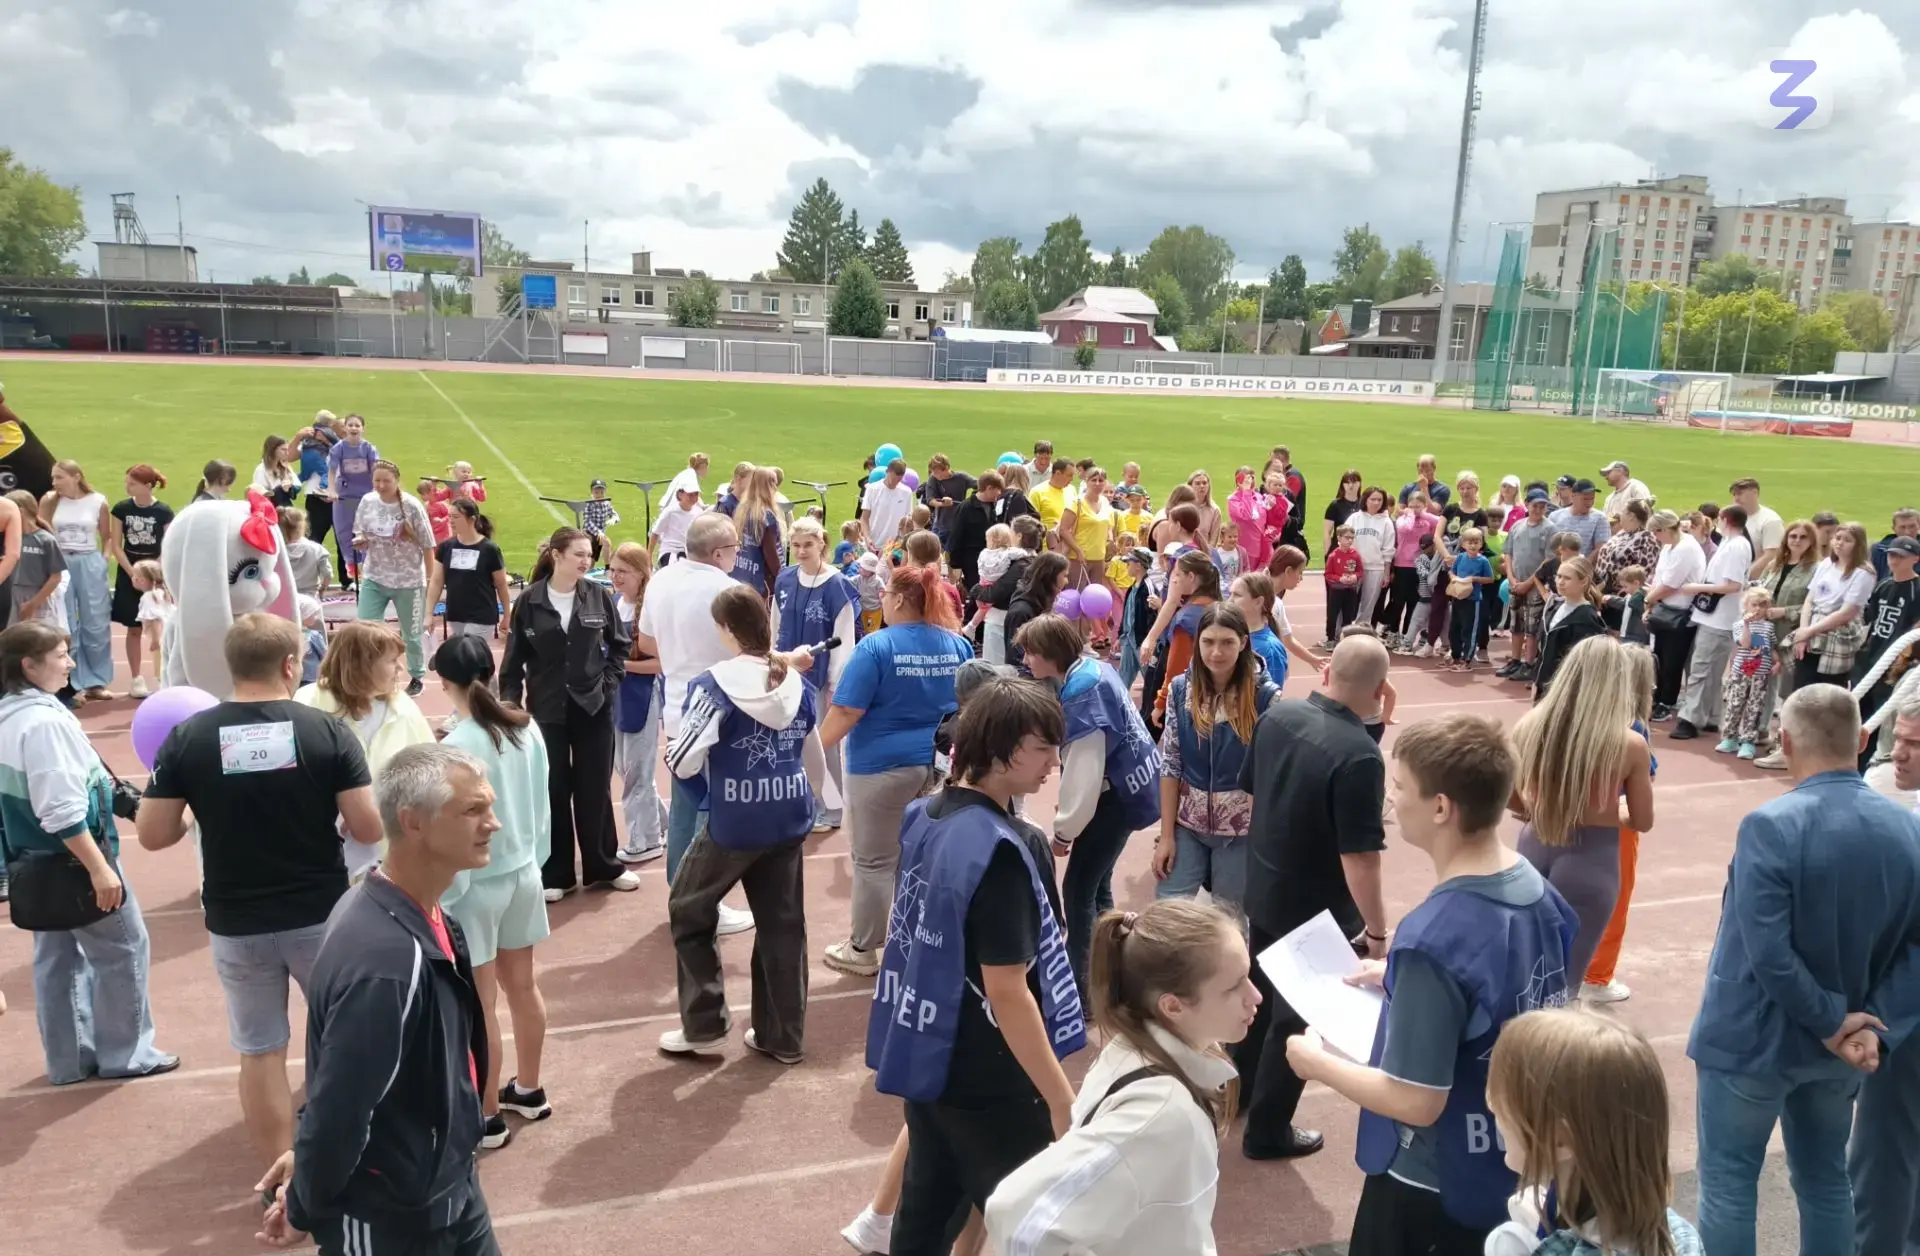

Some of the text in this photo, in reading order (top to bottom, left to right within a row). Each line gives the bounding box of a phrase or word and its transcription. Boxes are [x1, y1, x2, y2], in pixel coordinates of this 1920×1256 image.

[1016, 373, 1402, 393] ПРАВИТЕЛЬСТВО БРЯНСКОЙ ОБЛАСТИ
[893, 654, 939, 665] МНОГОДЕТНЫЕ
[896, 667, 925, 677] БРЯНСКА
[931, 666, 958, 677] ОБЛАСТ
[249, 749, 268, 761] 20
[724, 767, 808, 803] ВОЛОНТ
